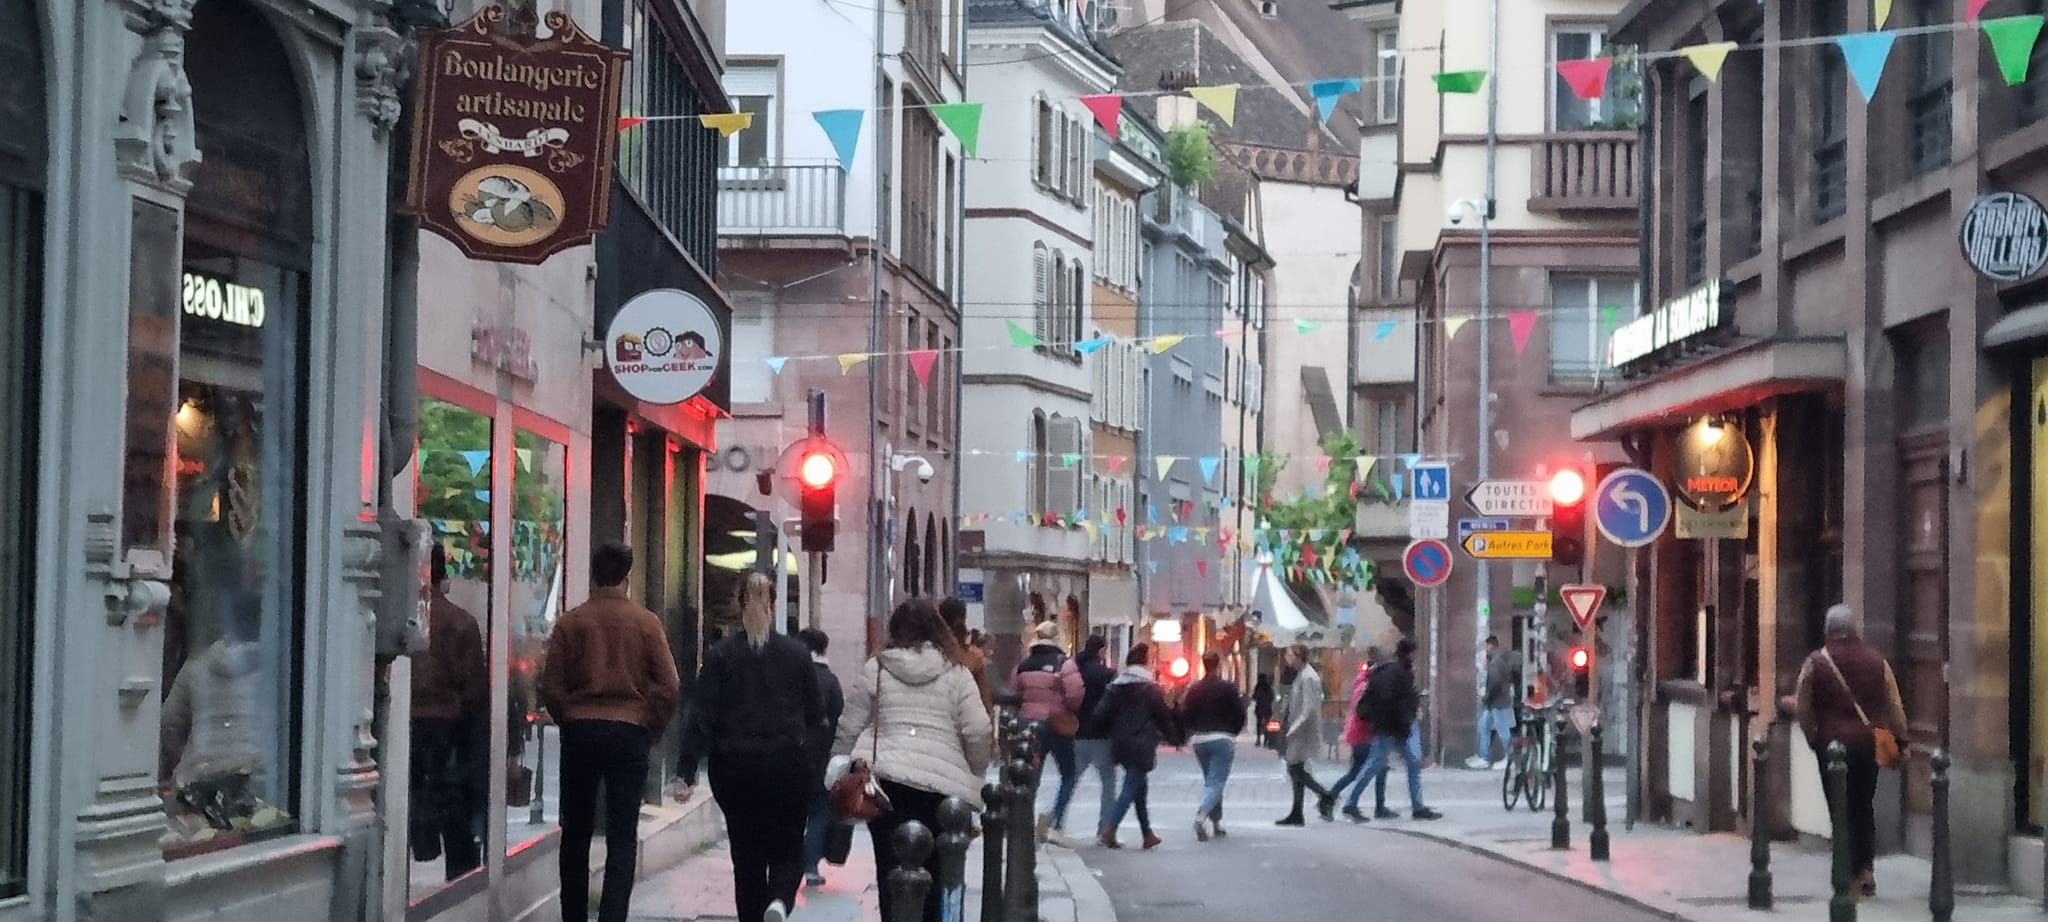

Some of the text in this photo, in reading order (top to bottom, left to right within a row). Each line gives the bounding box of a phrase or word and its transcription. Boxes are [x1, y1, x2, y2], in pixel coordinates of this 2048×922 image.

[445, 50, 599, 91] Boulangerie
[456, 91, 585, 125] artisanale
[1485, 485, 1537, 497] TOUTES
